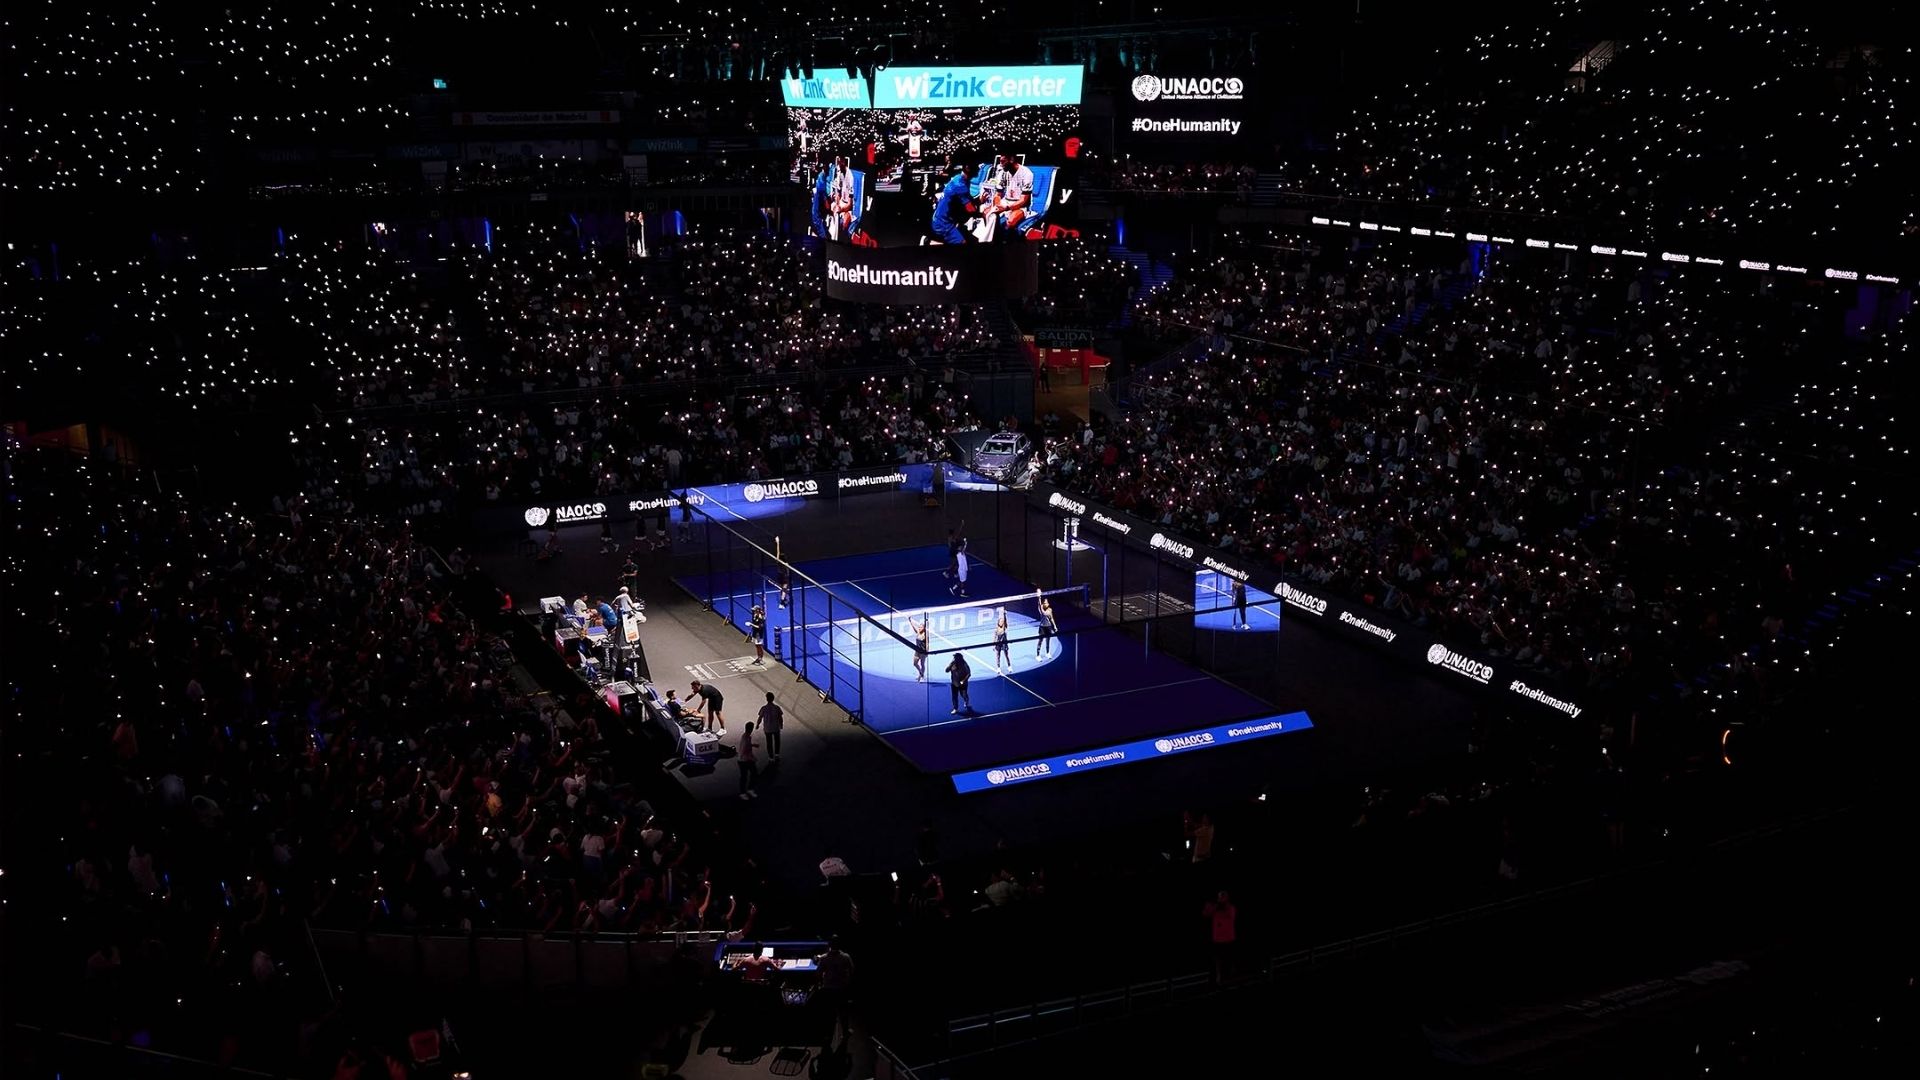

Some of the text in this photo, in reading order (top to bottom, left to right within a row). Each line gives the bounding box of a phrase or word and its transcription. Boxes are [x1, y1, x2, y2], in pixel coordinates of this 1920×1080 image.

[1132, 118, 1241, 135] #OneHumanity
[828, 260, 959, 289] #OneHumanity
[838, 472, 907, 488] #OneHumanity
[629, 495, 705, 512] #OneHumnity
[1339, 611, 1397, 643] #OneHumanity
[1509, 679, 1582, 719] #OneHumanity
[1066, 751, 1125, 768] #OneHumanity
[1228, 720, 1282, 738] #OneHumanity
